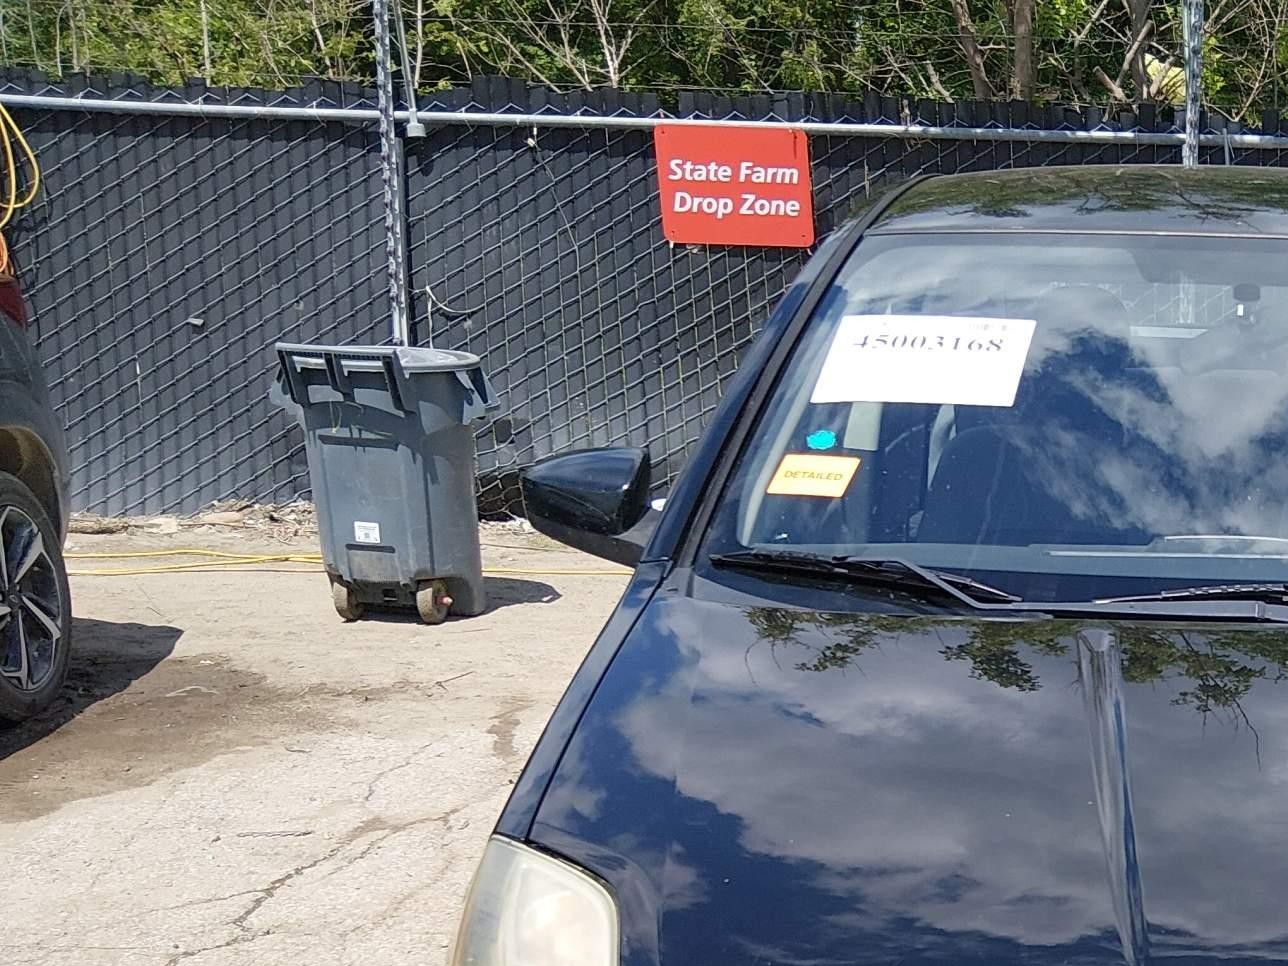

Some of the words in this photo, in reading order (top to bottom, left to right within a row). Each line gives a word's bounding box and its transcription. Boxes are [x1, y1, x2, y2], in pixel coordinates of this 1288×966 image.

[668, 158, 732, 182] State
[739, 161, 799, 184] Farm
[673, 191, 734, 219] Drop
[739, 193, 800, 217] Zone
[852, 334, 1004, 352] 45003168
[783, 470, 843, 481] DETAILED
